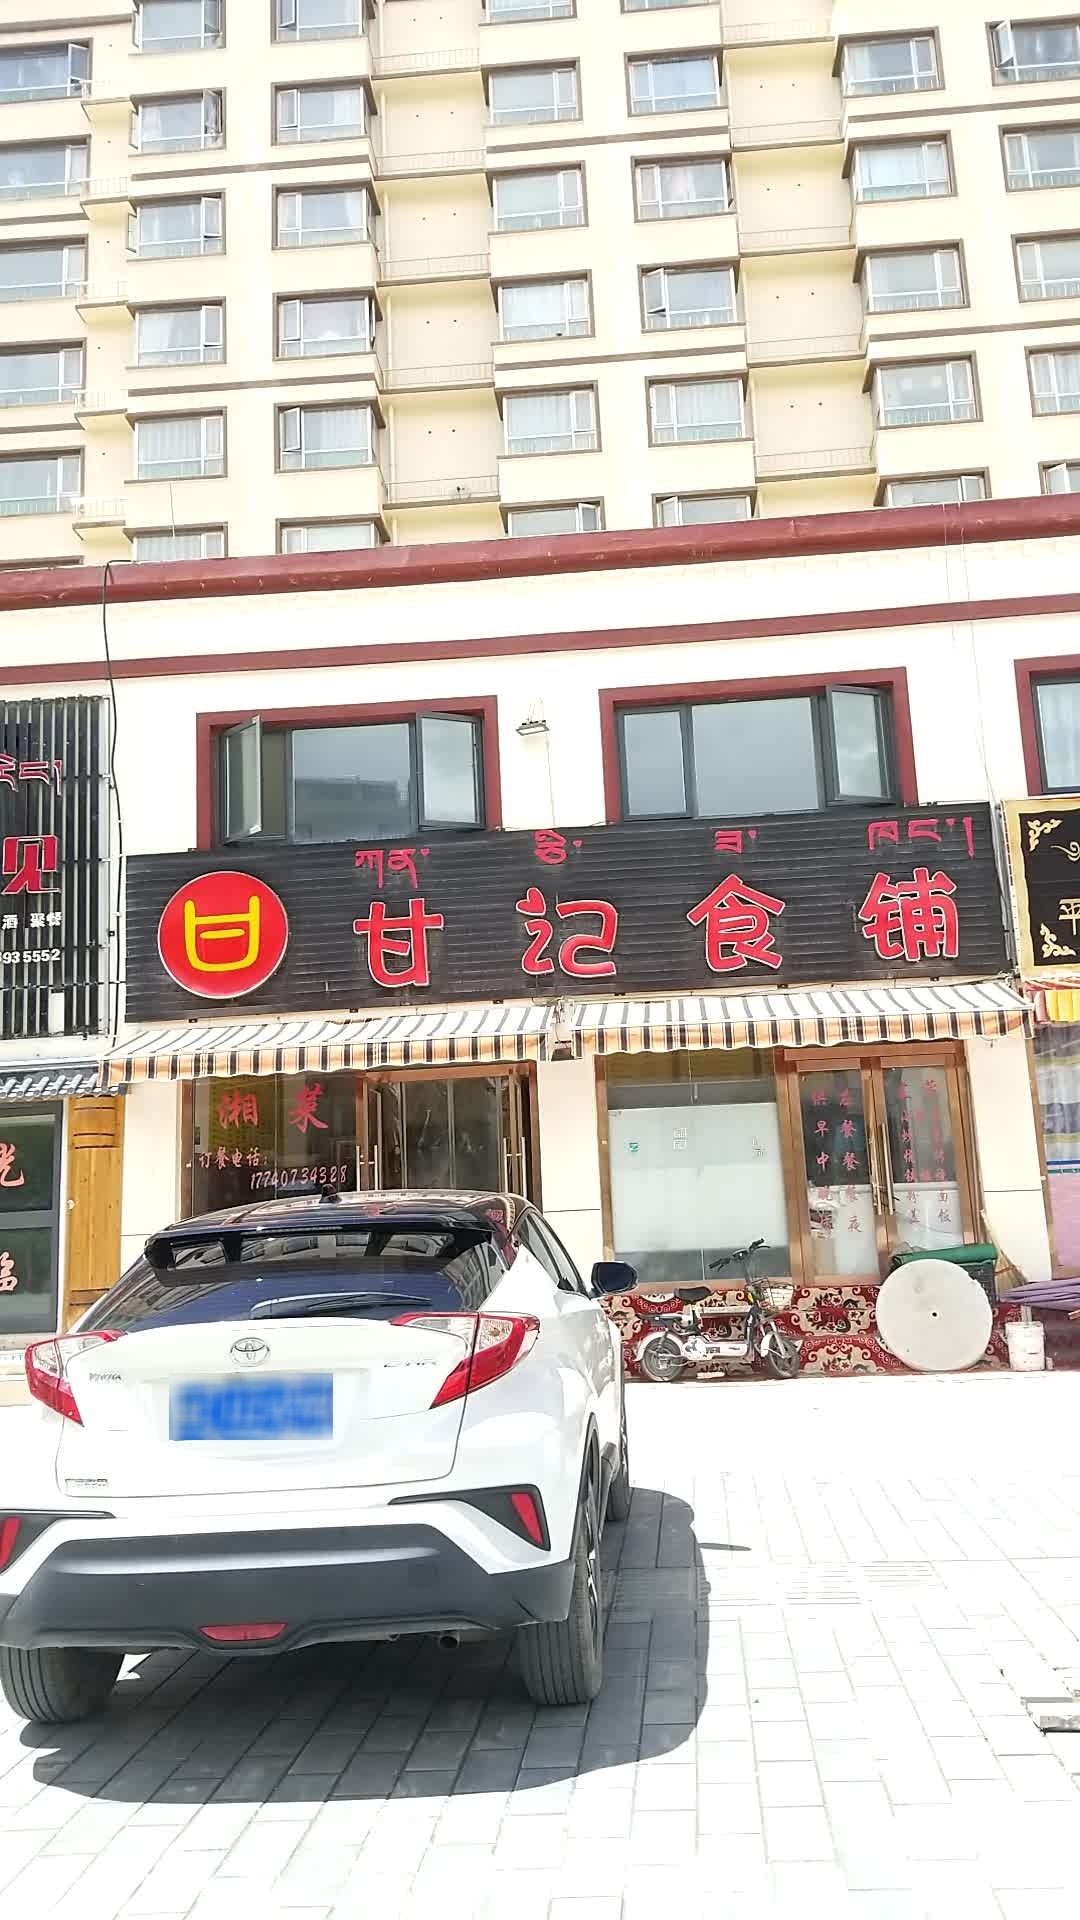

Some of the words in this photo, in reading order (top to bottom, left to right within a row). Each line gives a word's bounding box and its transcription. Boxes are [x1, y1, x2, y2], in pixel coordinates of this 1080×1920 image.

[1, 834, 62, 895] 见
[352, 867, 958, 989] 甘记食铺
[250, 1164, 348, 1190] 17740734328
